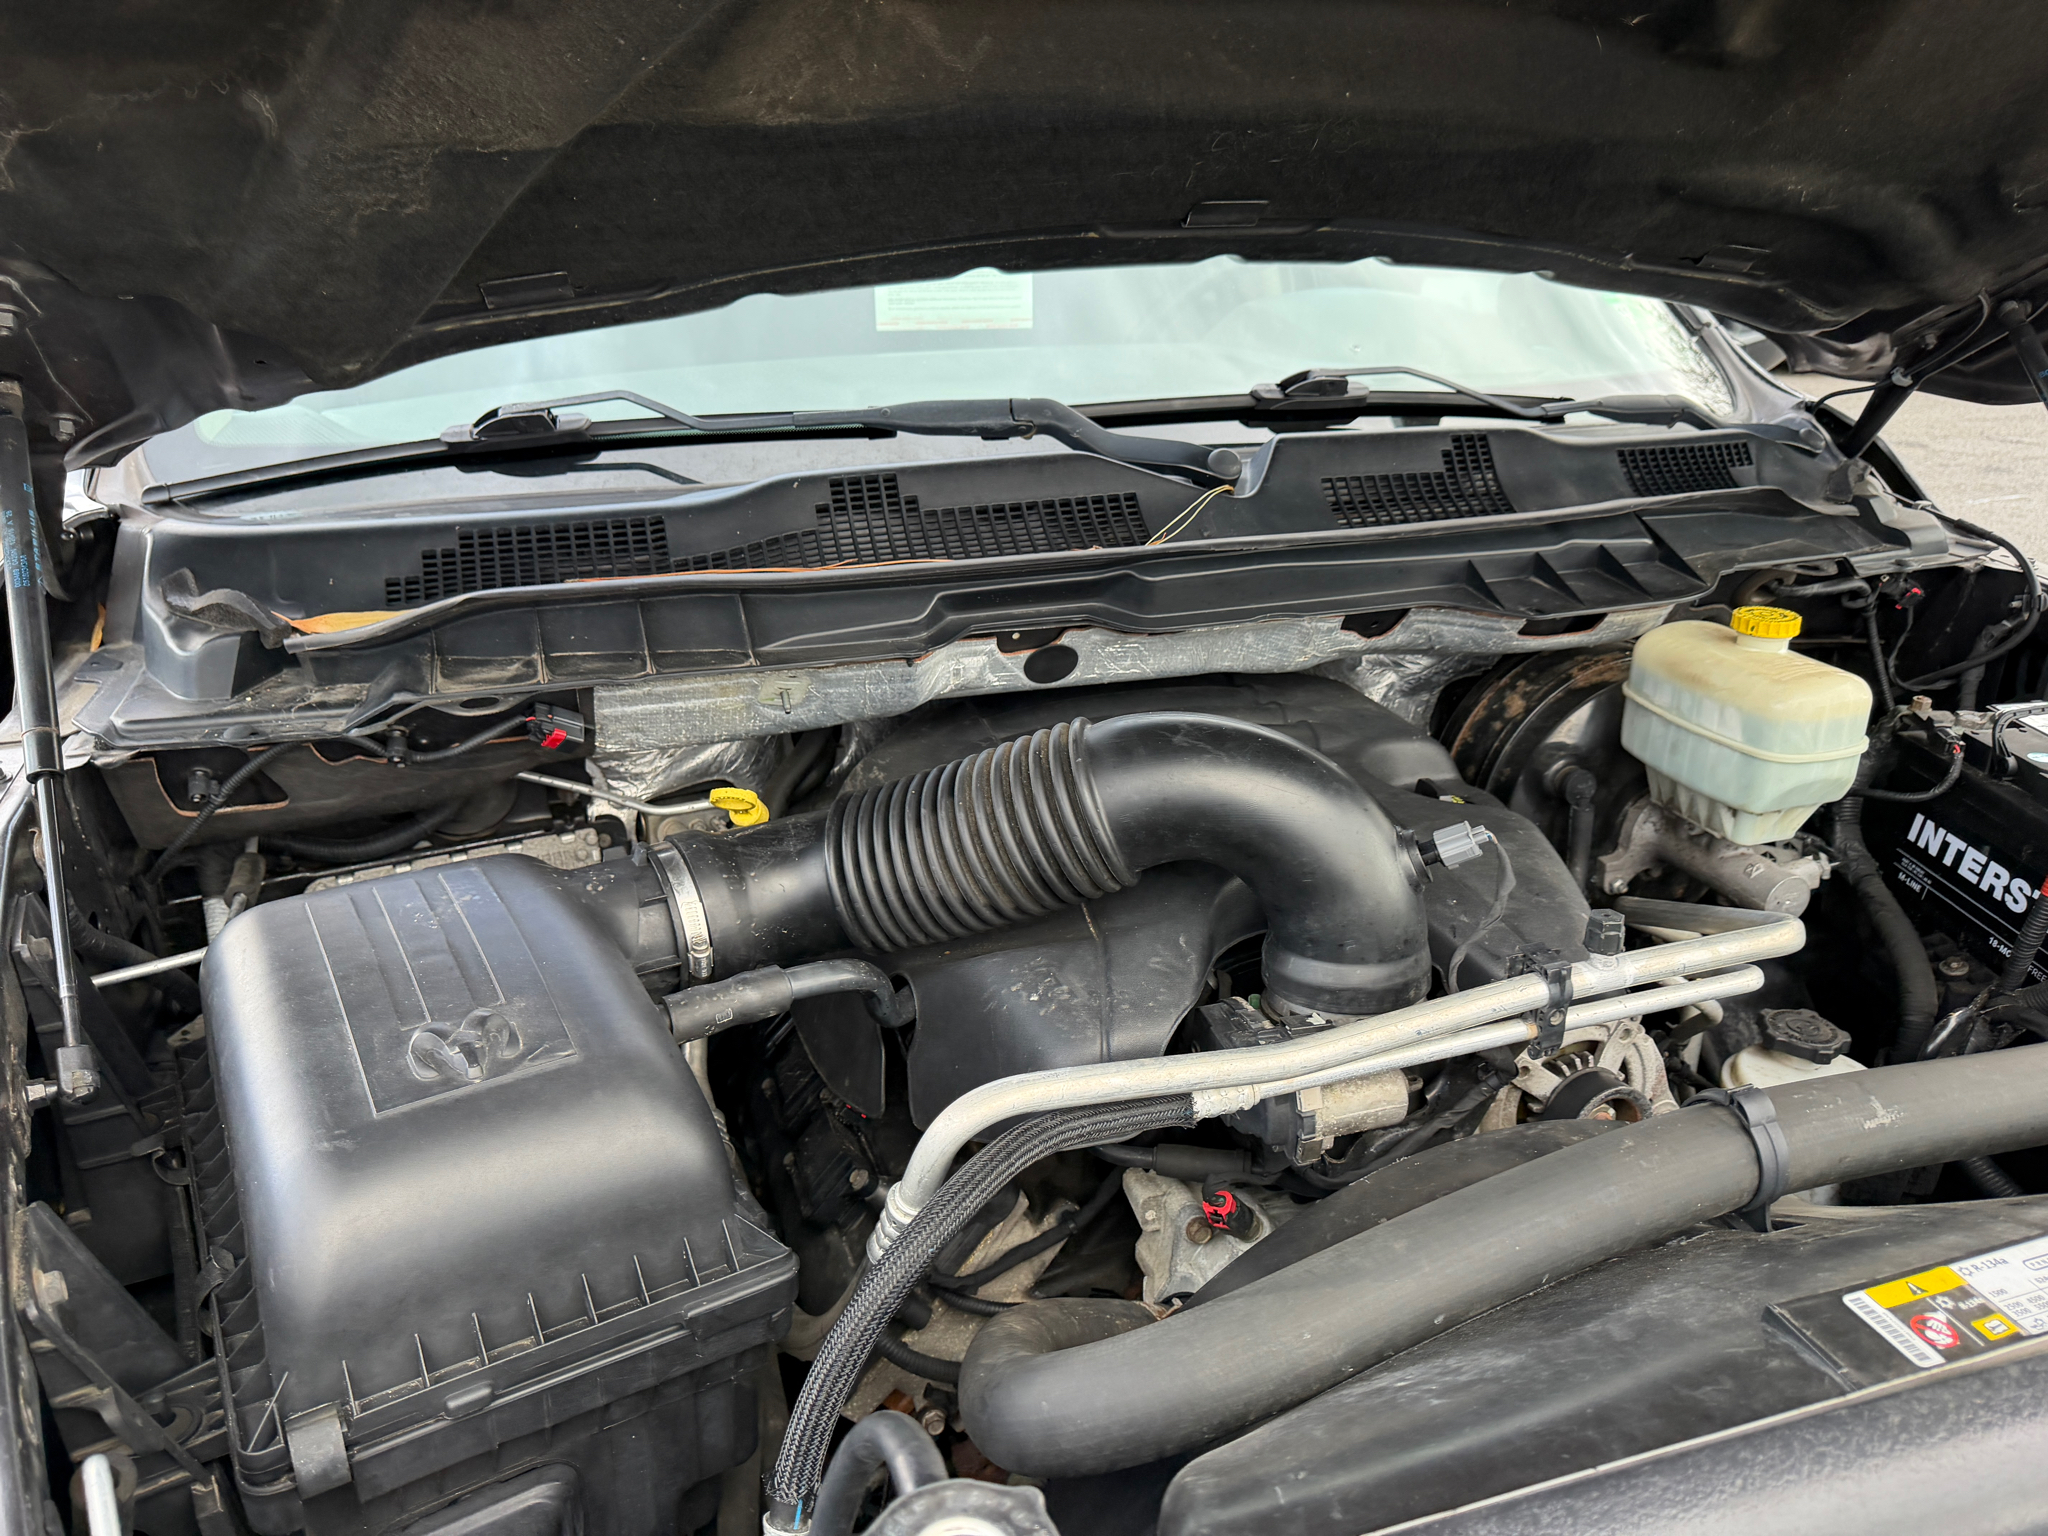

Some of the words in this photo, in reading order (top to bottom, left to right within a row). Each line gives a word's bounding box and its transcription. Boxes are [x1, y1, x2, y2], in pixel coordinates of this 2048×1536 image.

[1907, 812, 2041, 914] INTERS
[2027, 964, 2048, 983] FREE
[1971, 1257, 2009, 1272] R-134a
[1988, 1288, 2008, 1298] 1500
